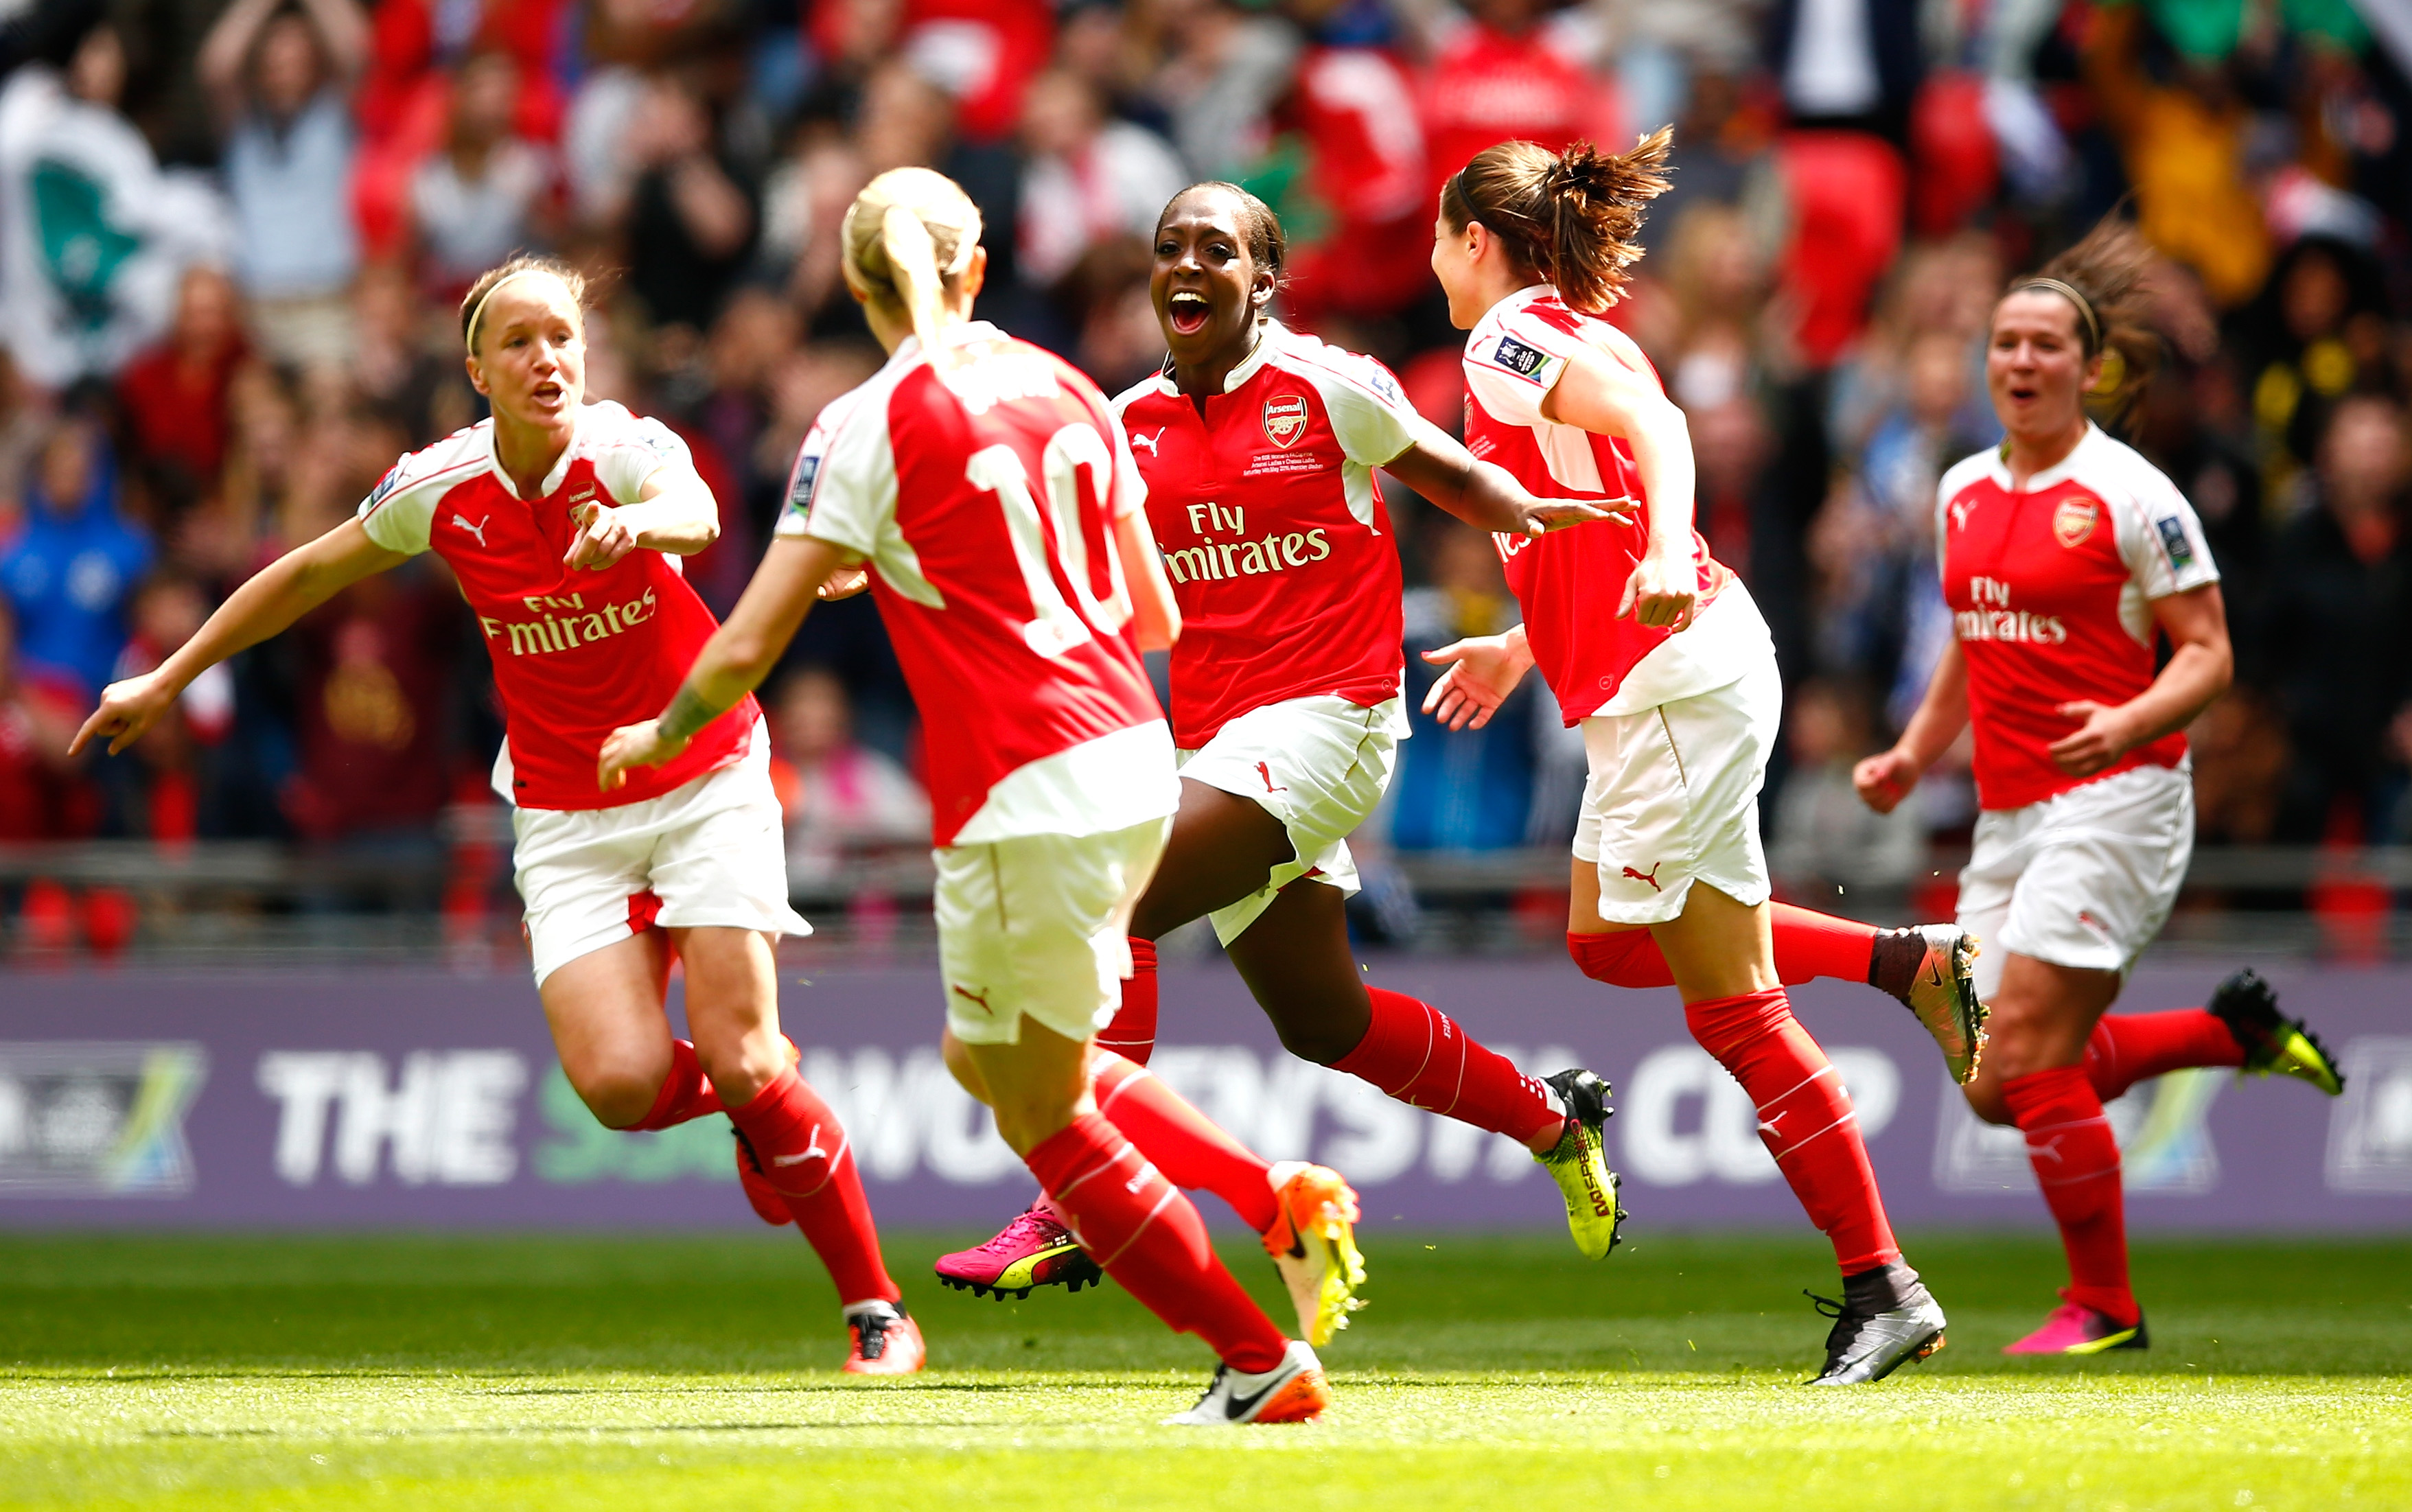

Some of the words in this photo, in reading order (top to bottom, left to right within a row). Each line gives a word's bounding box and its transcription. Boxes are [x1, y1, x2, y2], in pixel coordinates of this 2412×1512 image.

[1267, 402, 1301, 414] Arsenal
[1186, 502, 1244, 535] Fly
[965, 422, 1135, 658] 10
[1164, 528, 1330, 584] mirates
[523, 592, 584, 614] Fly
[1970, 576, 2010, 609] Fly
[1956, 601, 2067, 645] mirates
[257, 1049, 527, 1186] THE
